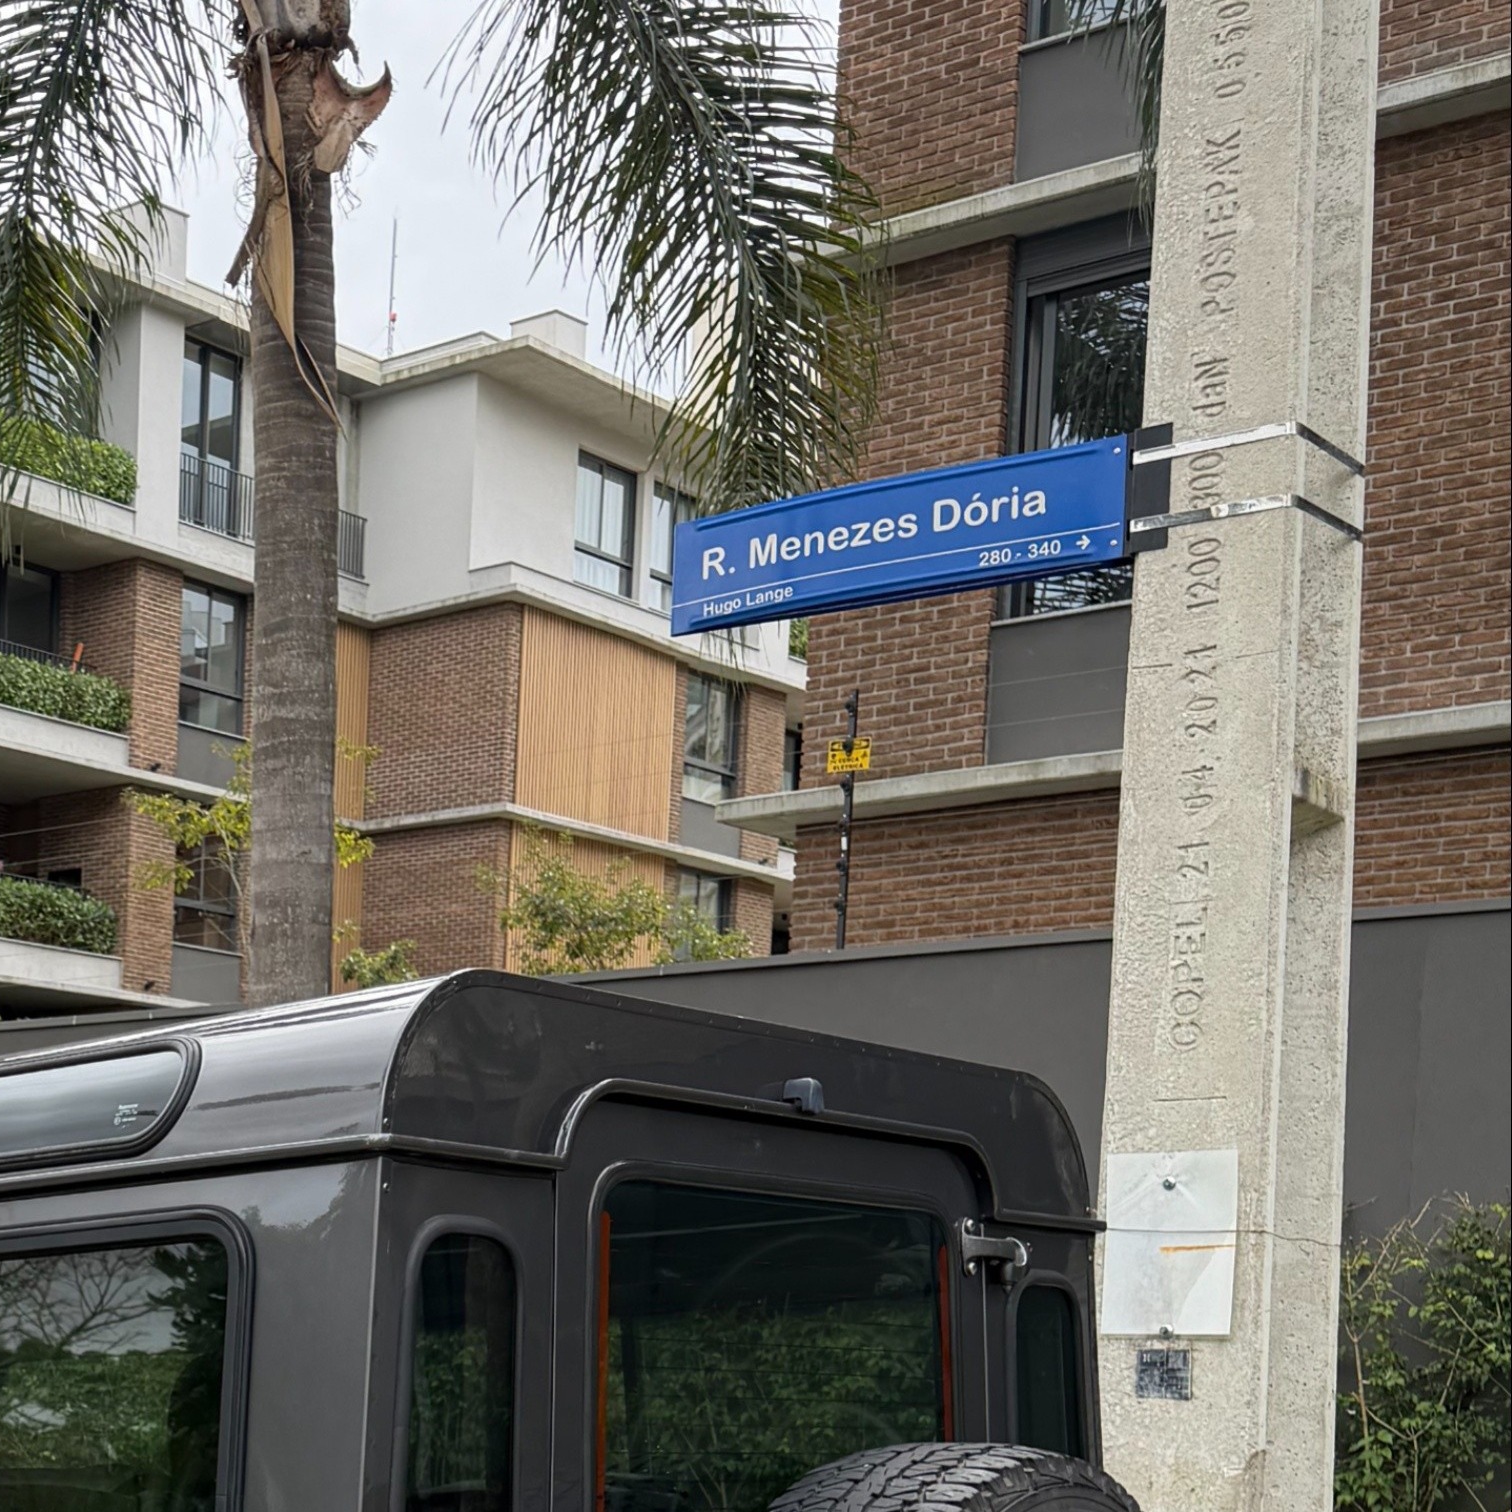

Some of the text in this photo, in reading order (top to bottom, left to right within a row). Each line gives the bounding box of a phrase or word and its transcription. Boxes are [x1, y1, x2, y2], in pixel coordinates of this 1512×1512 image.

[1199, 129, 1243, 315] POSTEPAK
[1191, 356, 1231, 417] daN
[700, 485, 1047, 581] R. Menezes Dória
[979, 549, 1012, 567] 280
[1028, 540, 1061, 560] 340
[703, 585, 793, 617] Hugo Lange
[1184, 538, 1222, 610] 1200
[1177, 765, 1214, 809] 04
[1176, 841, 1210, 878] 21
[1167, 905, 1208, 1052] COPEL
